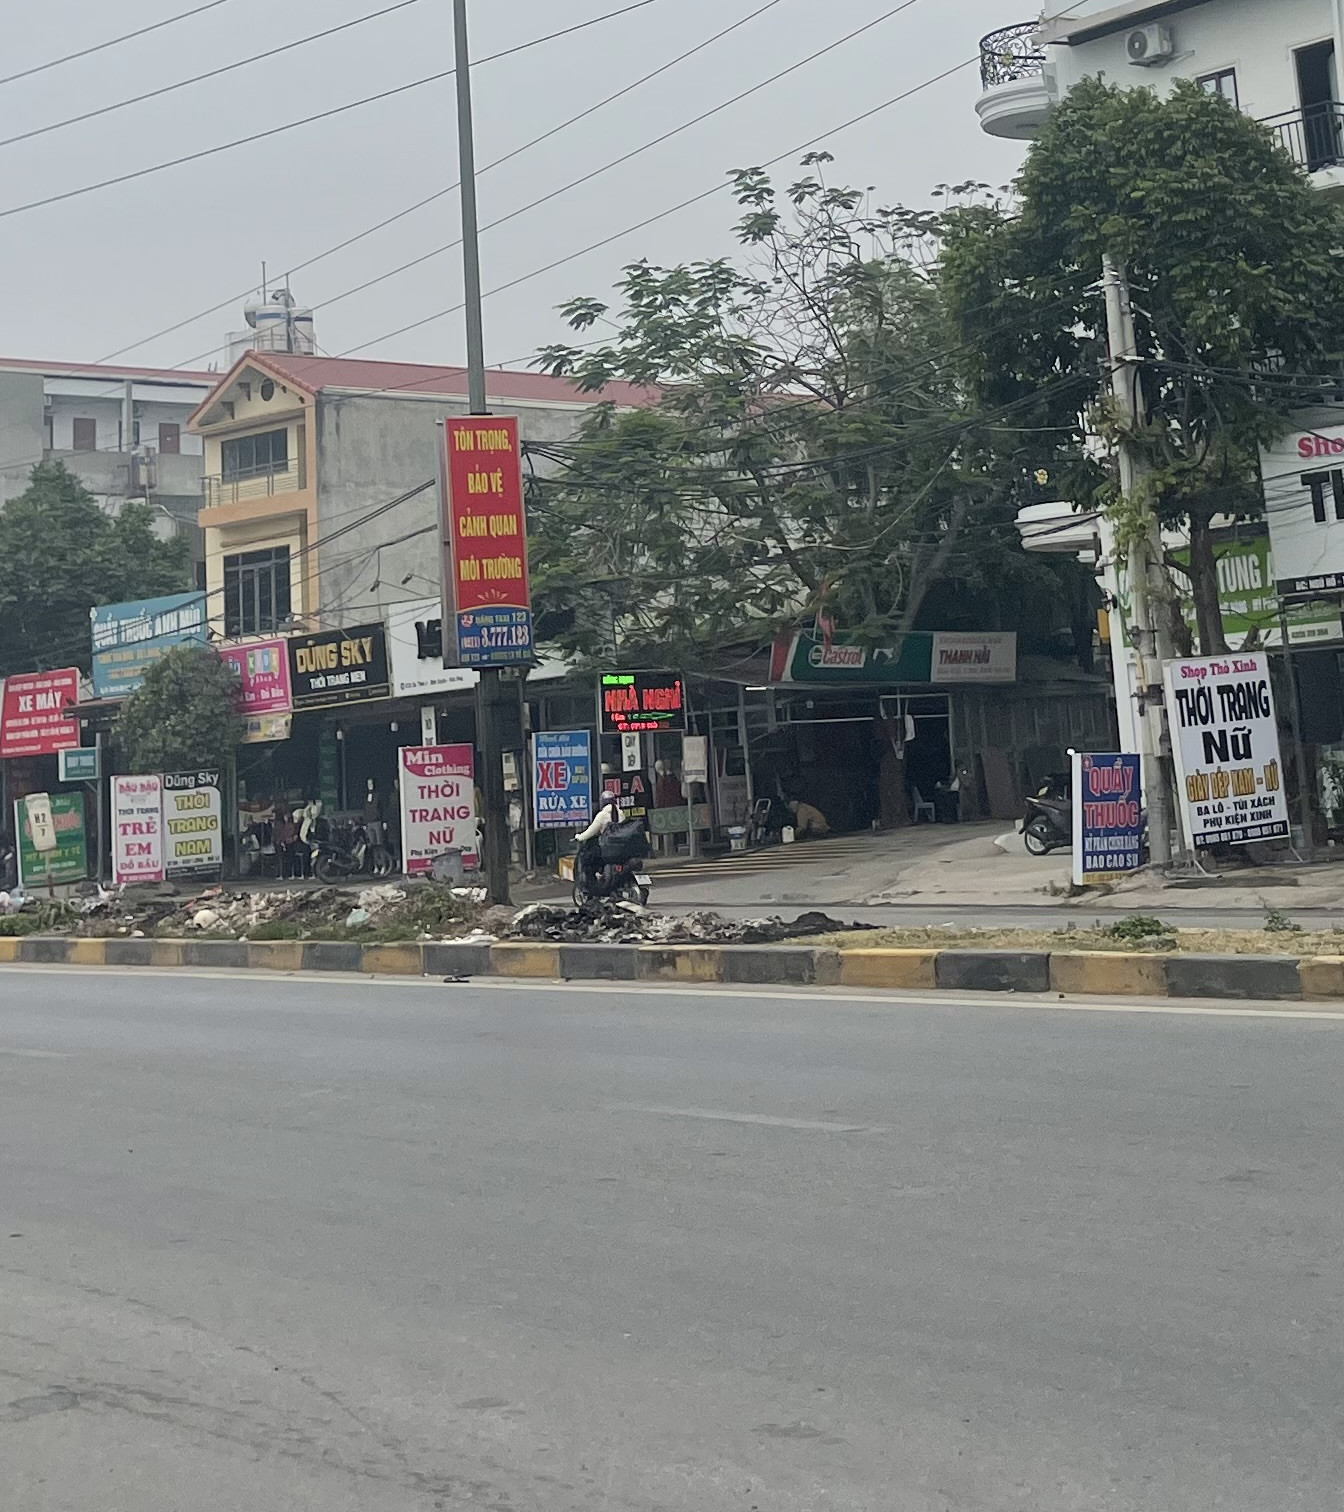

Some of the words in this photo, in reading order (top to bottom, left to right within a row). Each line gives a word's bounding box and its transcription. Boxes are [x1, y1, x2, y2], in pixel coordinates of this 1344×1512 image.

[453, 426, 474, 451] TÔN
[467, 464, 488, 494] BẢO
[489, 467, 504, 498] VỆ
[459, 507, 488, 537] CẢNH
[489, 514, 518, 539] QUAN
[459, 556, 480, 581] MÔI
[482, 552, 523, 580] TRƯỜNG
[1215, 550, 1263, 594] TÙNG
[295, 640, 338, 674] DŨNG
[340, 636, 373, 667] SKY
[823, 648, 864, 666] Castrol
[1180, 665, 1207, 680] Shop
[1209, 661, 1230, 677] Thỏ
[1232, 658, 1258, 674] Xinh
[18, 694, 34, 713] XE
[35, 688, 62, 711] MÁY
[604, 684, 640, 713] NHÀ
[1175, 678, 1216, 728] THỜI
[1216, 679, 1272, 724] TRANG
[1202, 726, 1253, 765] NỮ
[405, 750, 444, 766] Min
[164, 774, 196, 788] Dũng
[197, 771, 220, 786] Sky
[423, 763, 471, 776] Clothing
[536, 759, 569, 792] XE
[417, 779, 460, 800] THỜI
[174, 790, 211, 811] THỜI
[569, 795, 588, 809] XE
[1196, 804, 1210, 816] BA
[1211, 801, 1225, 814] LÔ
[1232, 798, 1248, 811] TÚI
[1250, 795, 1276, 809] XÁCH
[409, 805, 471, 824] TRANG
[1084, 795, 1140, 829] THUỐC
[1203, 816, 1223, 829] PHỤ
[1224, 812, 1248, 826] KIỆN
[1249, 808, 1273, 822] XINH
[119, 815, 158, 836] TRẺ
[167, 814, 218, 835] TRANG
[428, 826, 455, 845] NỮ
[125, 842, 152, 857] EM
[174, 837, 213, 858] NAM
[1086, 854, 1105, 869] BAO
[1106, 853, 1125, 868] CAO
[1126, 853, 1139, 867] SU
